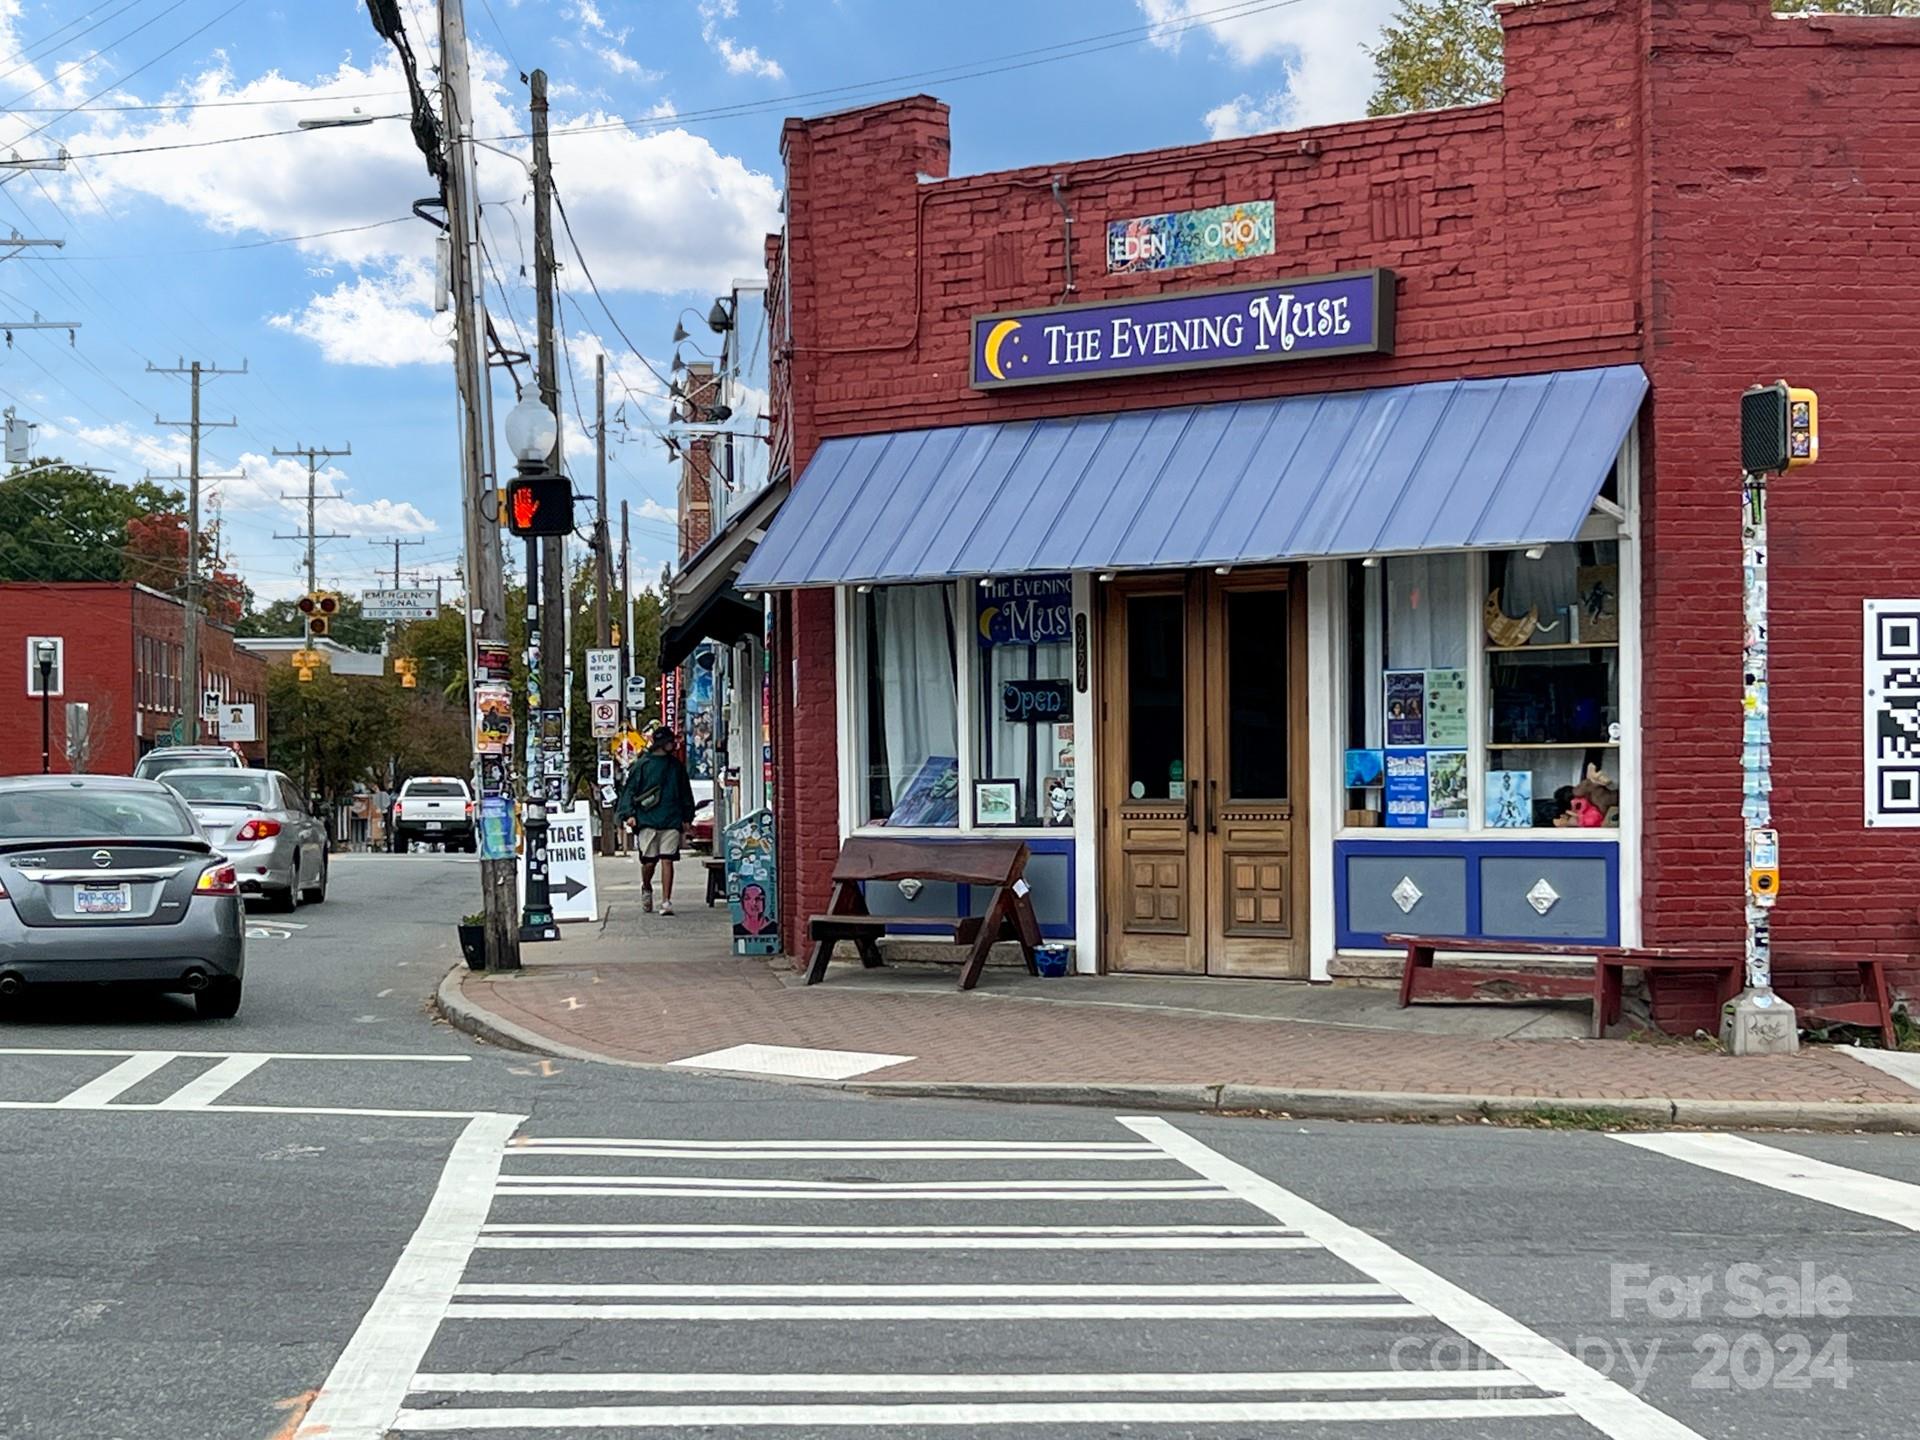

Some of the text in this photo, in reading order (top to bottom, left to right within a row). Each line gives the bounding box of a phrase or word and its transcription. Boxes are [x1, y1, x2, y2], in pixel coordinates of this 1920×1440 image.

[1113, 233, 1167, 261] EDEN
[1204, 215, 1272, 247] ORION
[365, 591, 433, 600] EMERGENCY
[380, 600, 419, 608] SIGNAL
[590, 654, 614, 664] STOP
[594, 674, 613, 682] RED
[1002, 683, 1061, 719] Open
